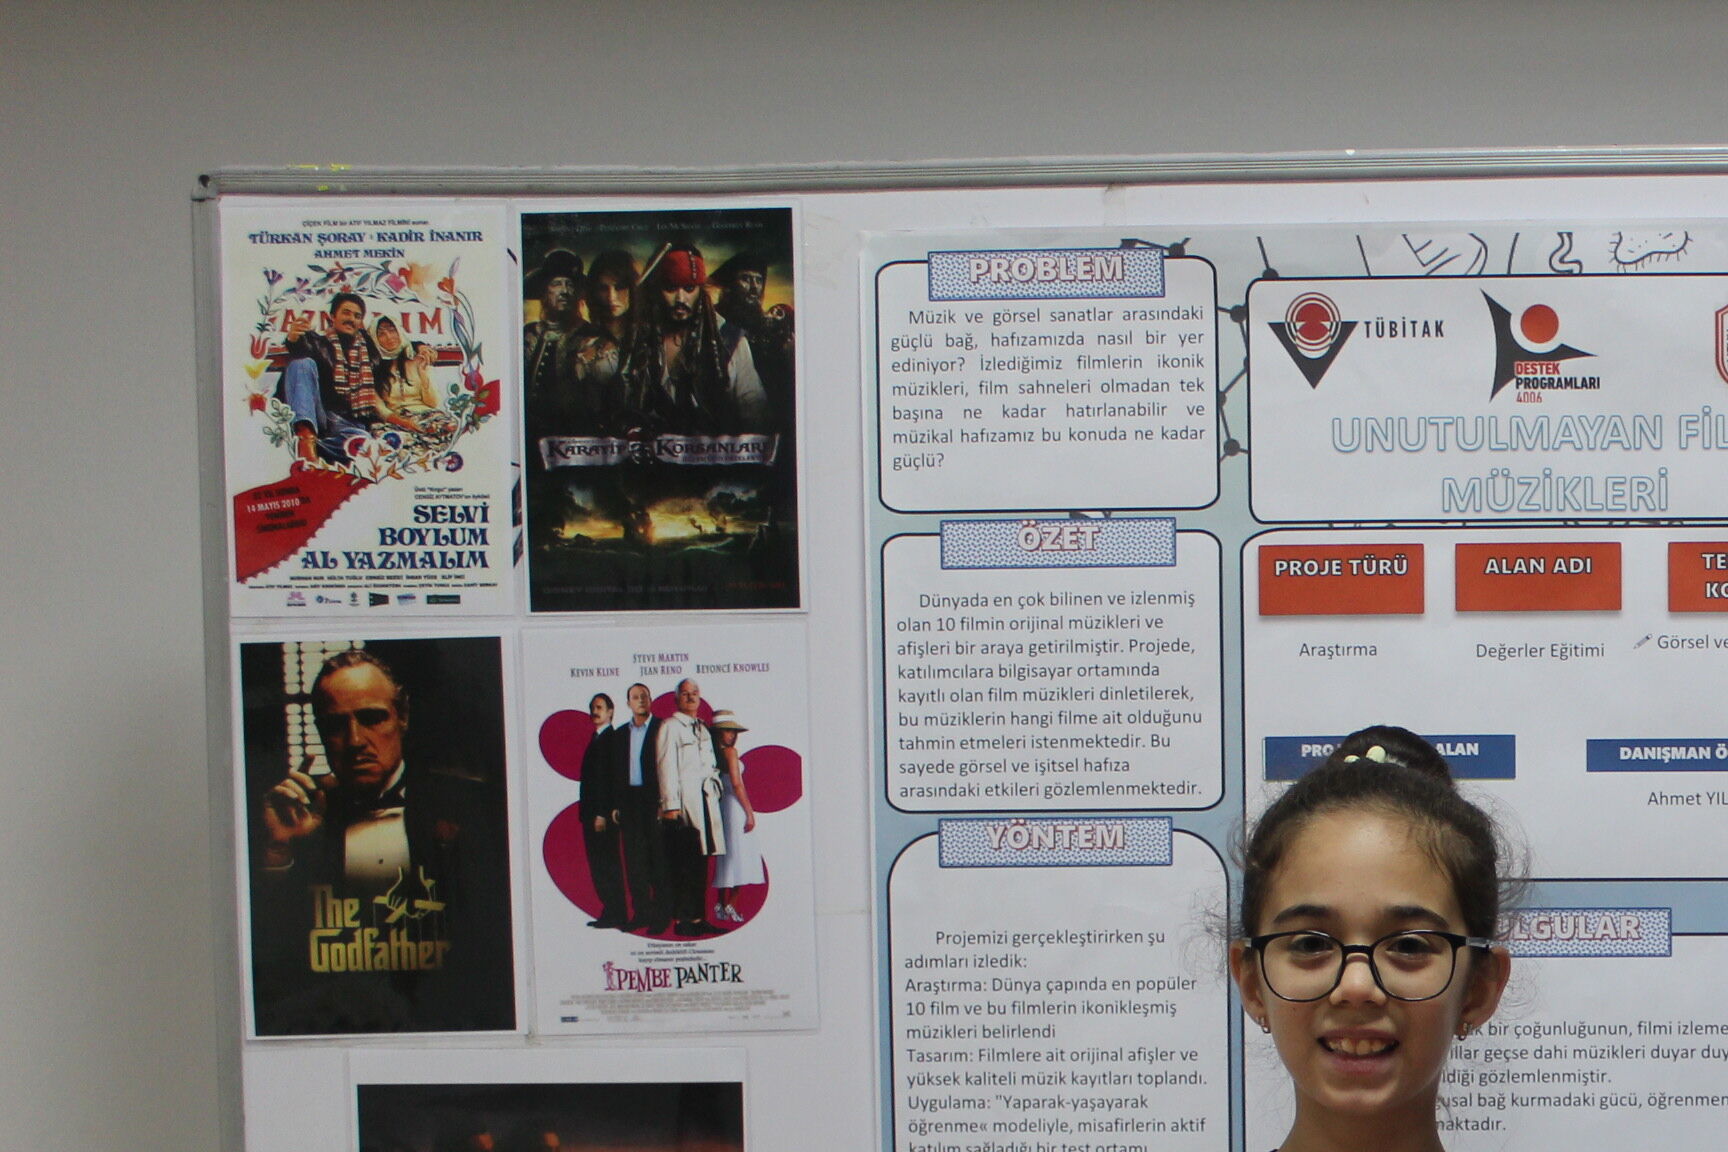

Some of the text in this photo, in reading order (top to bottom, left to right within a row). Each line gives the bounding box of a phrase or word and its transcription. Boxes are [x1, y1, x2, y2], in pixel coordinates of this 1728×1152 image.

[249, 229, 483, 246] TÜRKAN ŞORAY KADİR İNANIR
[969, 255, 1125, 284] PROBLEM
[1363, 318, 1446, 339] TÜBİTAK
[891, 329, 1205, 352] güçlü bağ, hafızamızda nasıl bir yer
[1516, 362, 1560, 375] DESTEK
[1516, 376, 1600, 390] PROGRAMLARI
[1516, 392, 1543, 404] 4006
[1331, 415, 1663, 453] UNUTULMAYAN
[1442, 467, 1669, 513] MÜZİKLERİ
[413, 501, 490, 524] SELVİ
[378, 527, 490, 546] BOYLUM
[1017, 519, 1101, 552] ÖZET
[301, 551, 490, 569] AL YAZMALIM
[1274, 554, 1408, 577] PROJE TÜRÜ
[1484, 556, 1592, 575] ALAN ADI
[897, 637, 1195, 659] afişleri bir araya getirilmiştir. Projede,
[1299, 643, 1377, 660] Araştırma
[1476, 642, 1604, 661] Değerler Eğitimi
[1657, 634, 1709, 649] Görsel
[1619, 745, 1711, 764] DANIŞMAN
[1647, 791, 1702, 806] Ahmet
[985, 818, 1126, 850] YÖNTEM
[310, 884, 360, 929] The
[1499, 914, 1641, 941] LGULAR
[308, 928, 452, 973] Godfather
[616, 962, 744, 992] PEMBE PANTER
[906, 1046, 1198, 1066] Tasarım: Filmlere ait orijinal afişler ve
[1450, 1045, 1480, 1060] ıllar
[1484, 1048, 1529, 1063] geçse
[1533, 1044, 1568, 1060] dahi
[1573, 1044, 1645, 1060] müzikleri
[1650, 1044, 1697, 1062] duyar
